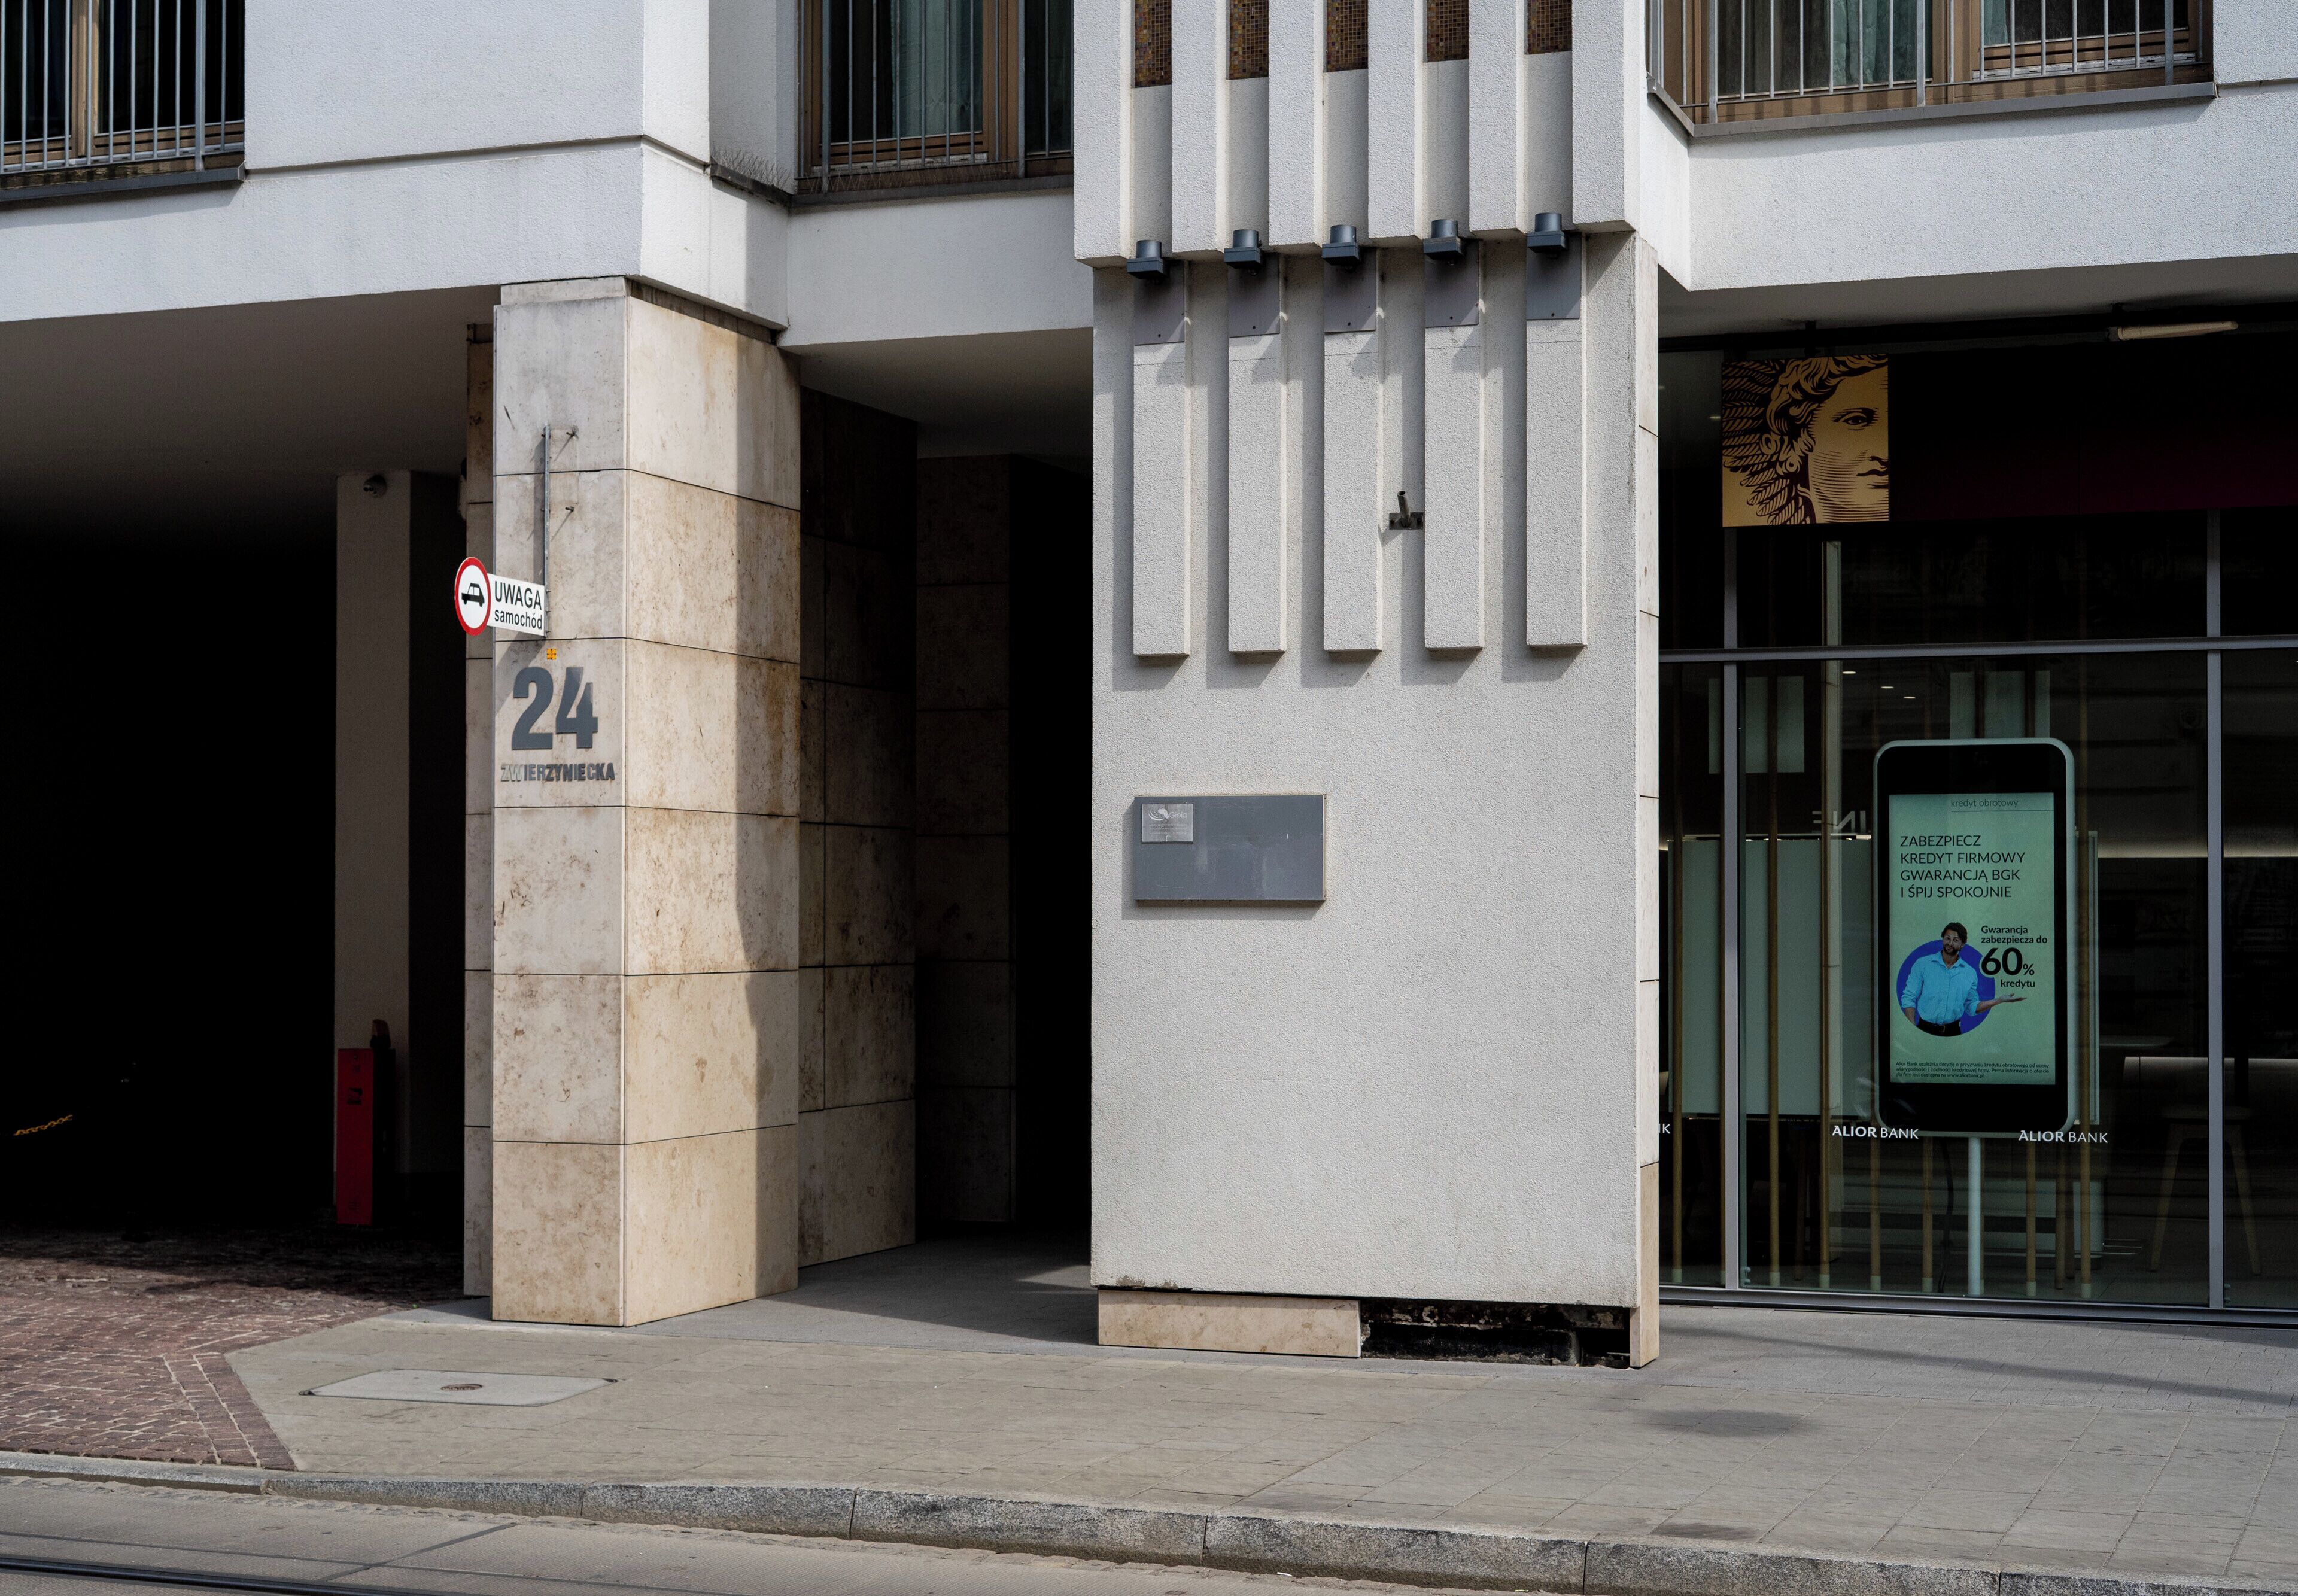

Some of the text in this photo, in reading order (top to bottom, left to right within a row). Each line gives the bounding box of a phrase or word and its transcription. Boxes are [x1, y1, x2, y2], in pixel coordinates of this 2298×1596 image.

[495, 581, 542, 610] UWAGA
[494, 609, 542, 630] samochód
[512, 667, 598, 750] 24
[501, 762, 616, 782] ZWIERZYNIECKA
[1950, 799, 2019, 808] kredyt obrotowy
[1900, 835, 1981, 847] ZABEZPIECZ
[1901, 852, 2025, 864] KREDYT FIRMOWY
[1900, 869, 2020, 883] GWARANCJĄ BGK
[1901, 884, 2012, 898] I ŚPIJ SPOKOJNIE
[1981, 925, 2028, 935] Gwarancja
[1981, 935, 2048, 945] zabezpiecza do
[1981, 947, 2035, 975] 60%
[2001, 979, 2035, 989] kredytu
[1832, 1125, 1919, 1139] ALIOR BANK
[2018, 1130, 2108, 1144] ALIOR BANK
